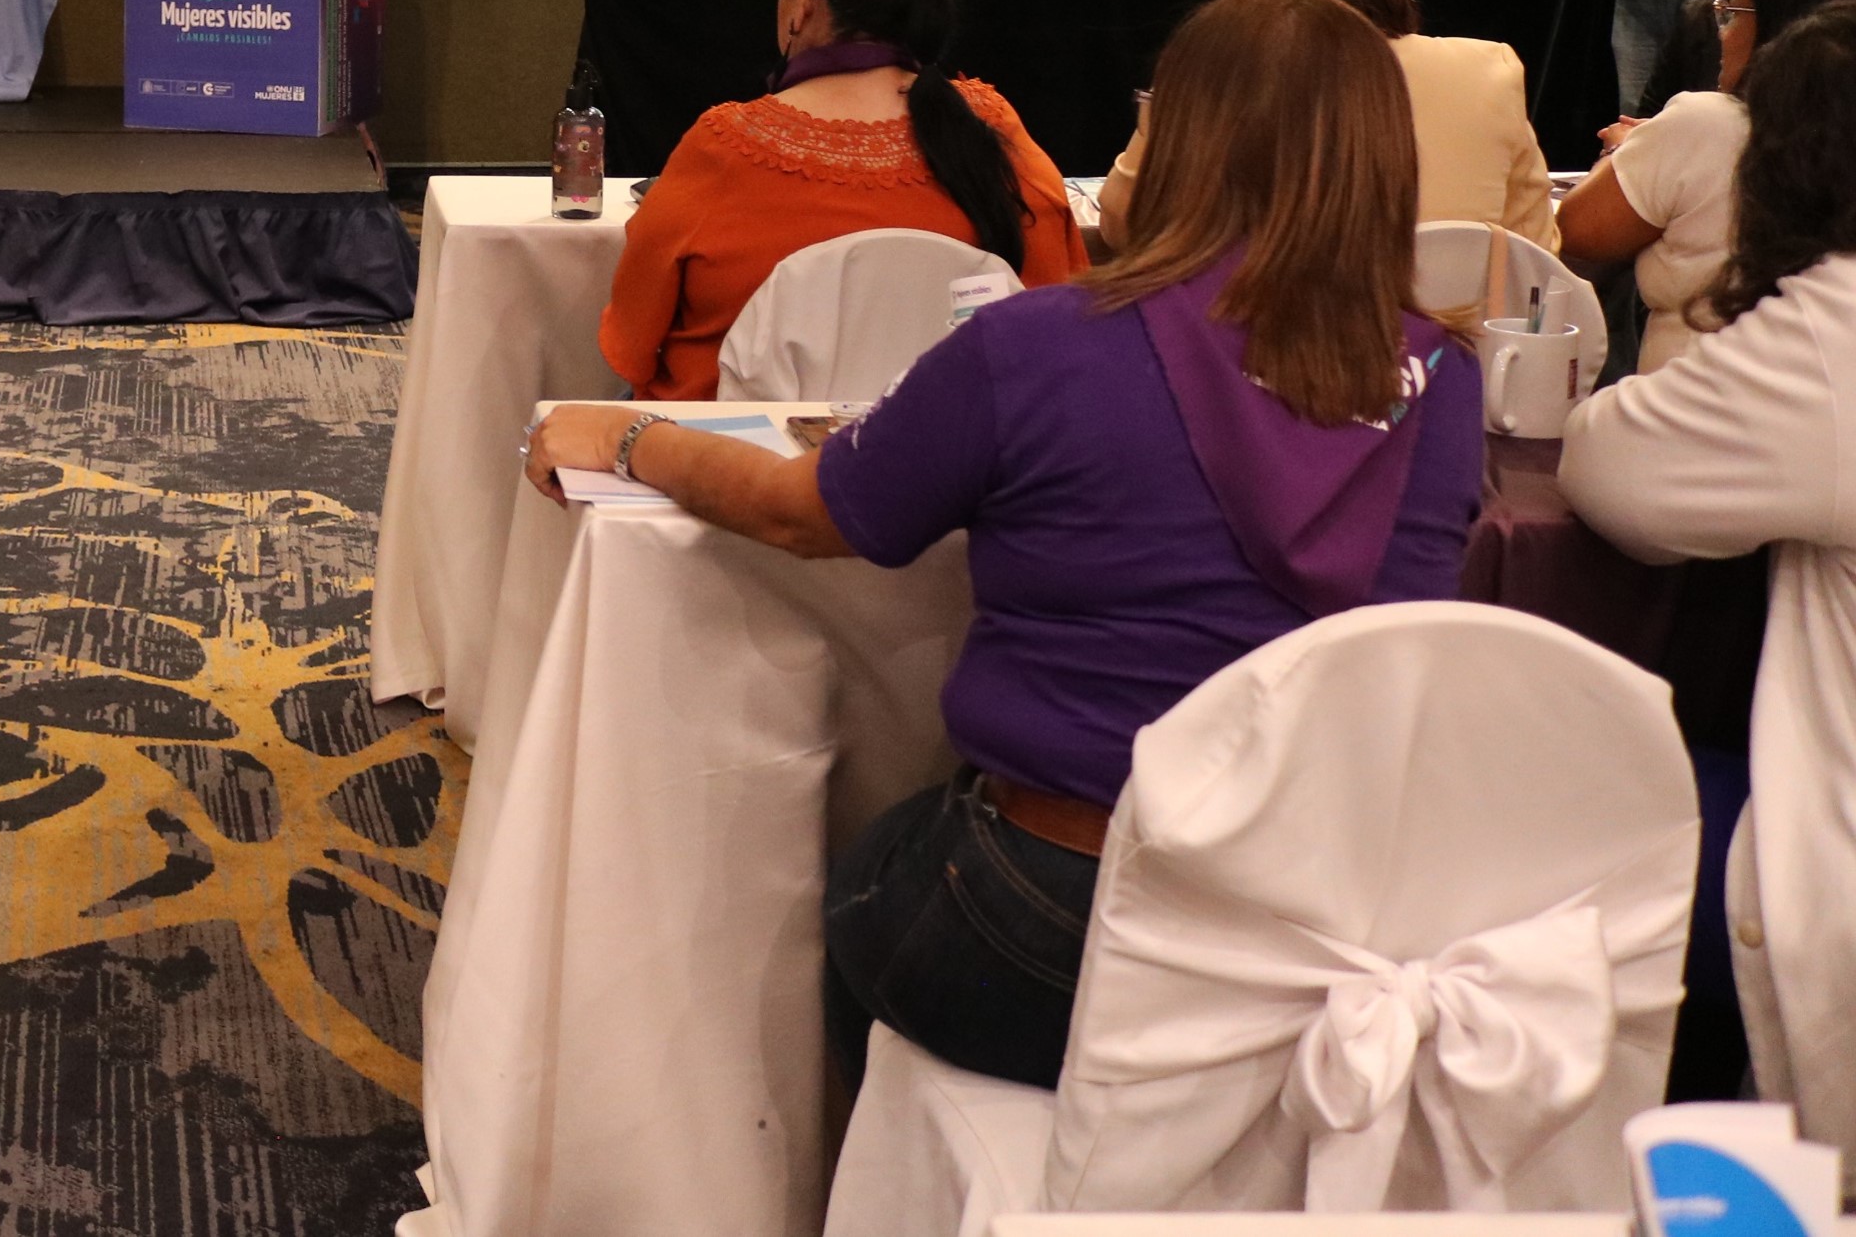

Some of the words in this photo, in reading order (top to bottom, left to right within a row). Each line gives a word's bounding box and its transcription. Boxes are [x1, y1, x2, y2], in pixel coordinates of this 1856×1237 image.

[160, 0, 226, 32] Mujeres
[227, 3, 292, 31] visibles
[254, 92, 293, 102] MUJERES
